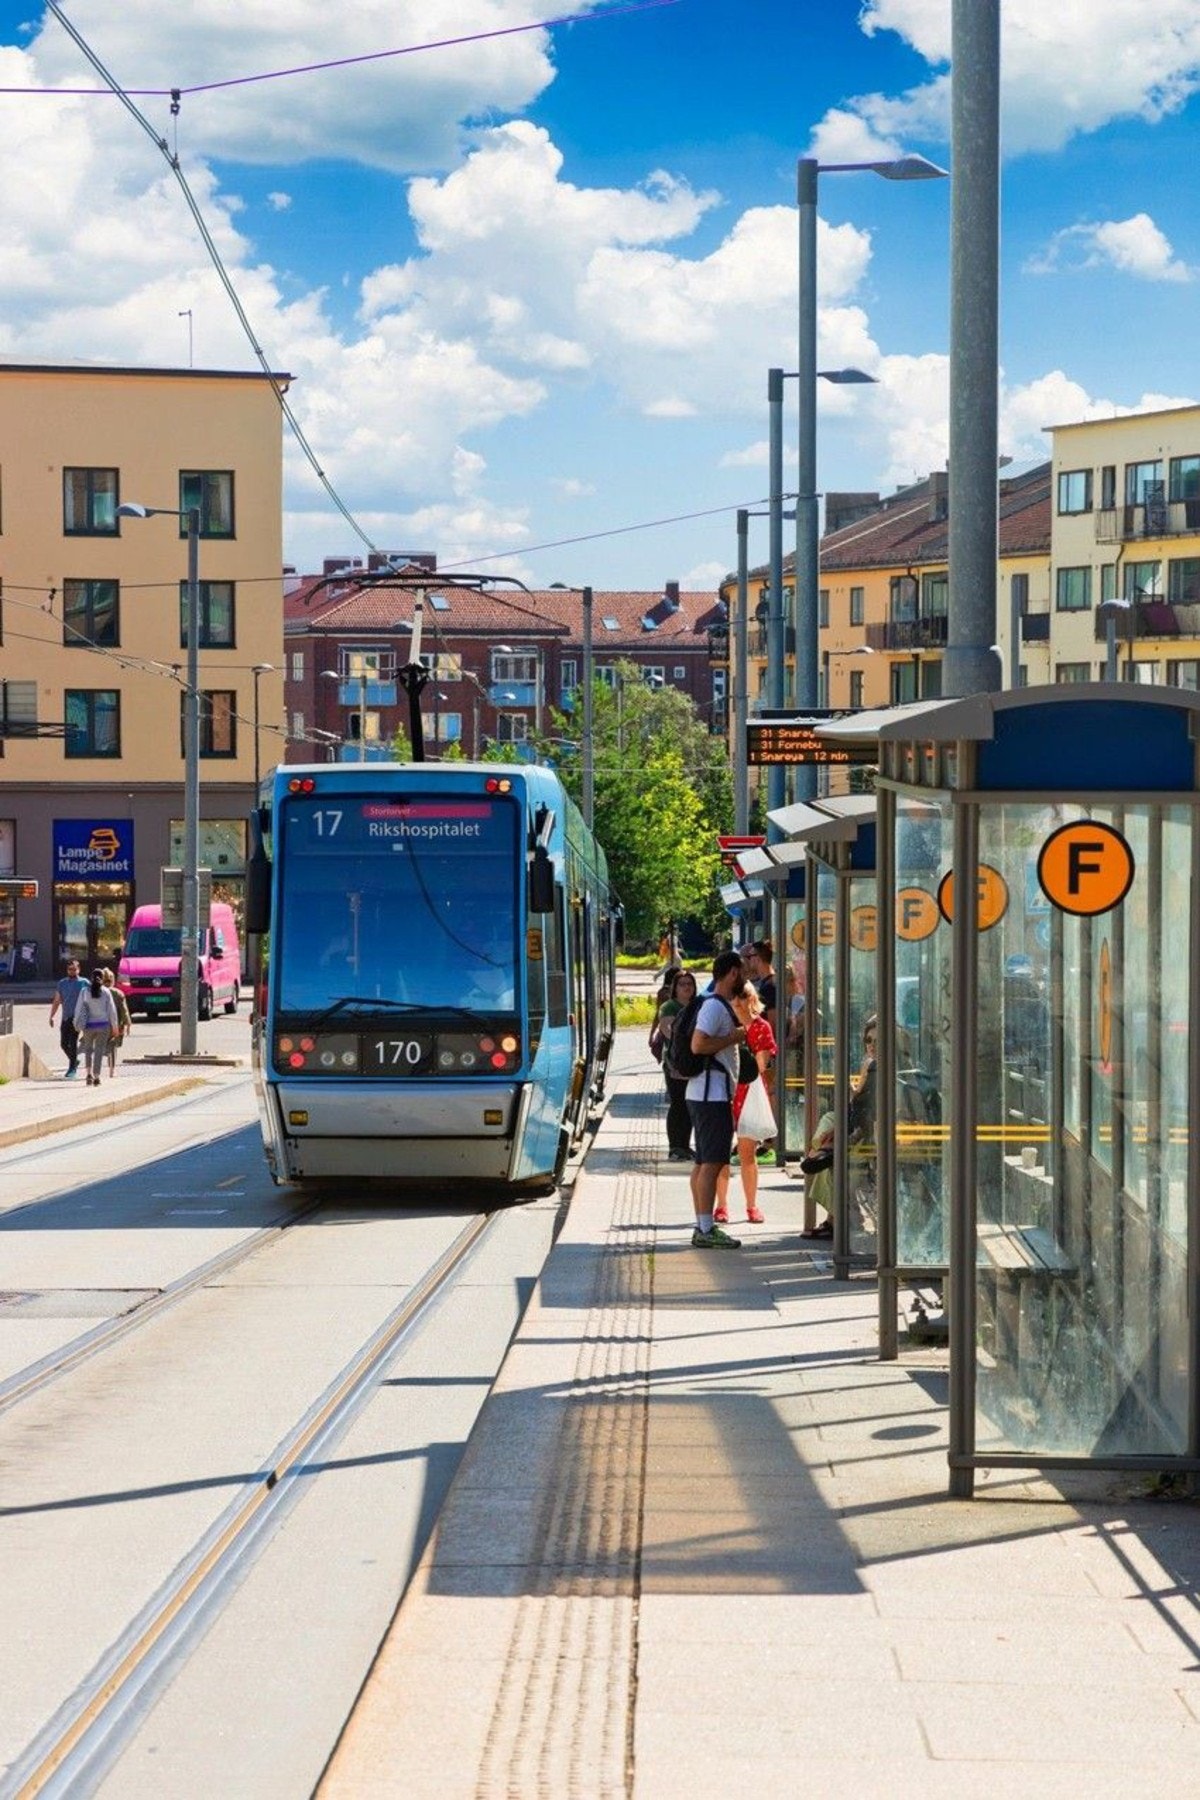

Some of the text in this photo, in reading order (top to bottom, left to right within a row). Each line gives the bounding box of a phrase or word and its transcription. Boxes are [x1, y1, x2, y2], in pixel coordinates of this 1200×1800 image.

[761, 730, 773, 738] 31
[761, 741, 822, 750] 31 Fornebu
[814, 752, 826, 761] 12
[831, 753, 849, 761] min
[312, 810, 342, 836] 17
[370, 823, 480, 838] Rikshospitalet
[58, 848, 104, 862] Lampe
[59, 861, 129, 874] Magasinet
[1068, 843, 1104, 894] F
[903, 899, 922, 929] F
[375, 1042, 421, 1064] 170
